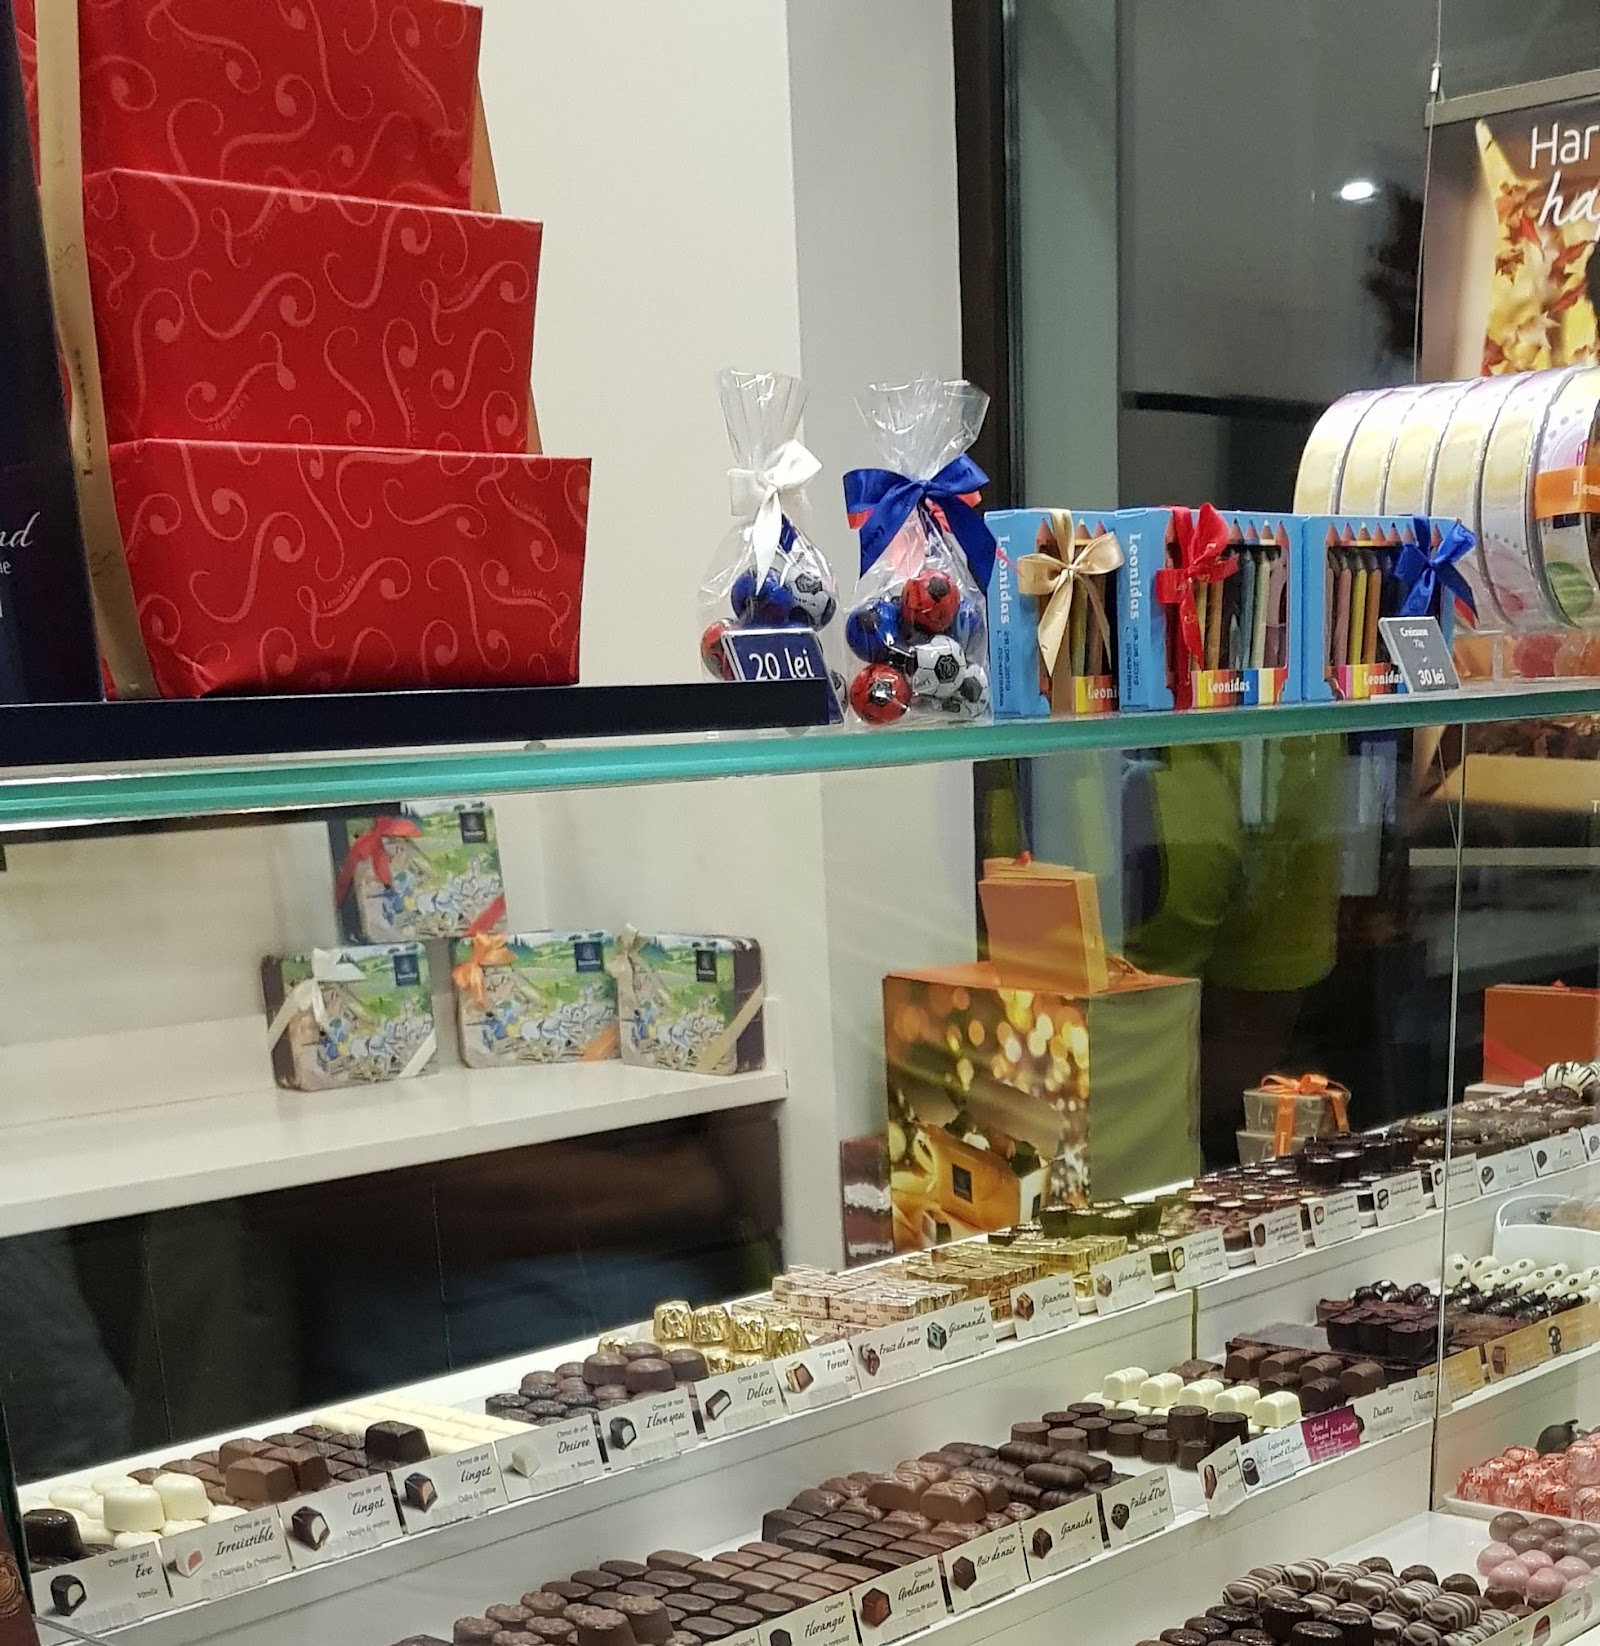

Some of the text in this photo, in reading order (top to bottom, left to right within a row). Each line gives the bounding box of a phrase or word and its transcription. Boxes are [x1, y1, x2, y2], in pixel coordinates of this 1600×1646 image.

[1530, 122, 1600, 169] Har
[1539, 168, 1600, 243] ha
[998, 535, 1013, 625] Leonidas
[1129, 533, 1142, 619] Leonidas
[748, 647, 815, 681] 20 lei
[1364, 671, 1404, 685] Leonidas
[1417, 668, 1446, 686] 30 lei
[1208, 678, 1250, 694] Leonidas
[747, 1382, 774, 1401] Delice
[215, 1525, 275, 1556] Irresistible
[135, 1563, 153, 1579] Eve
